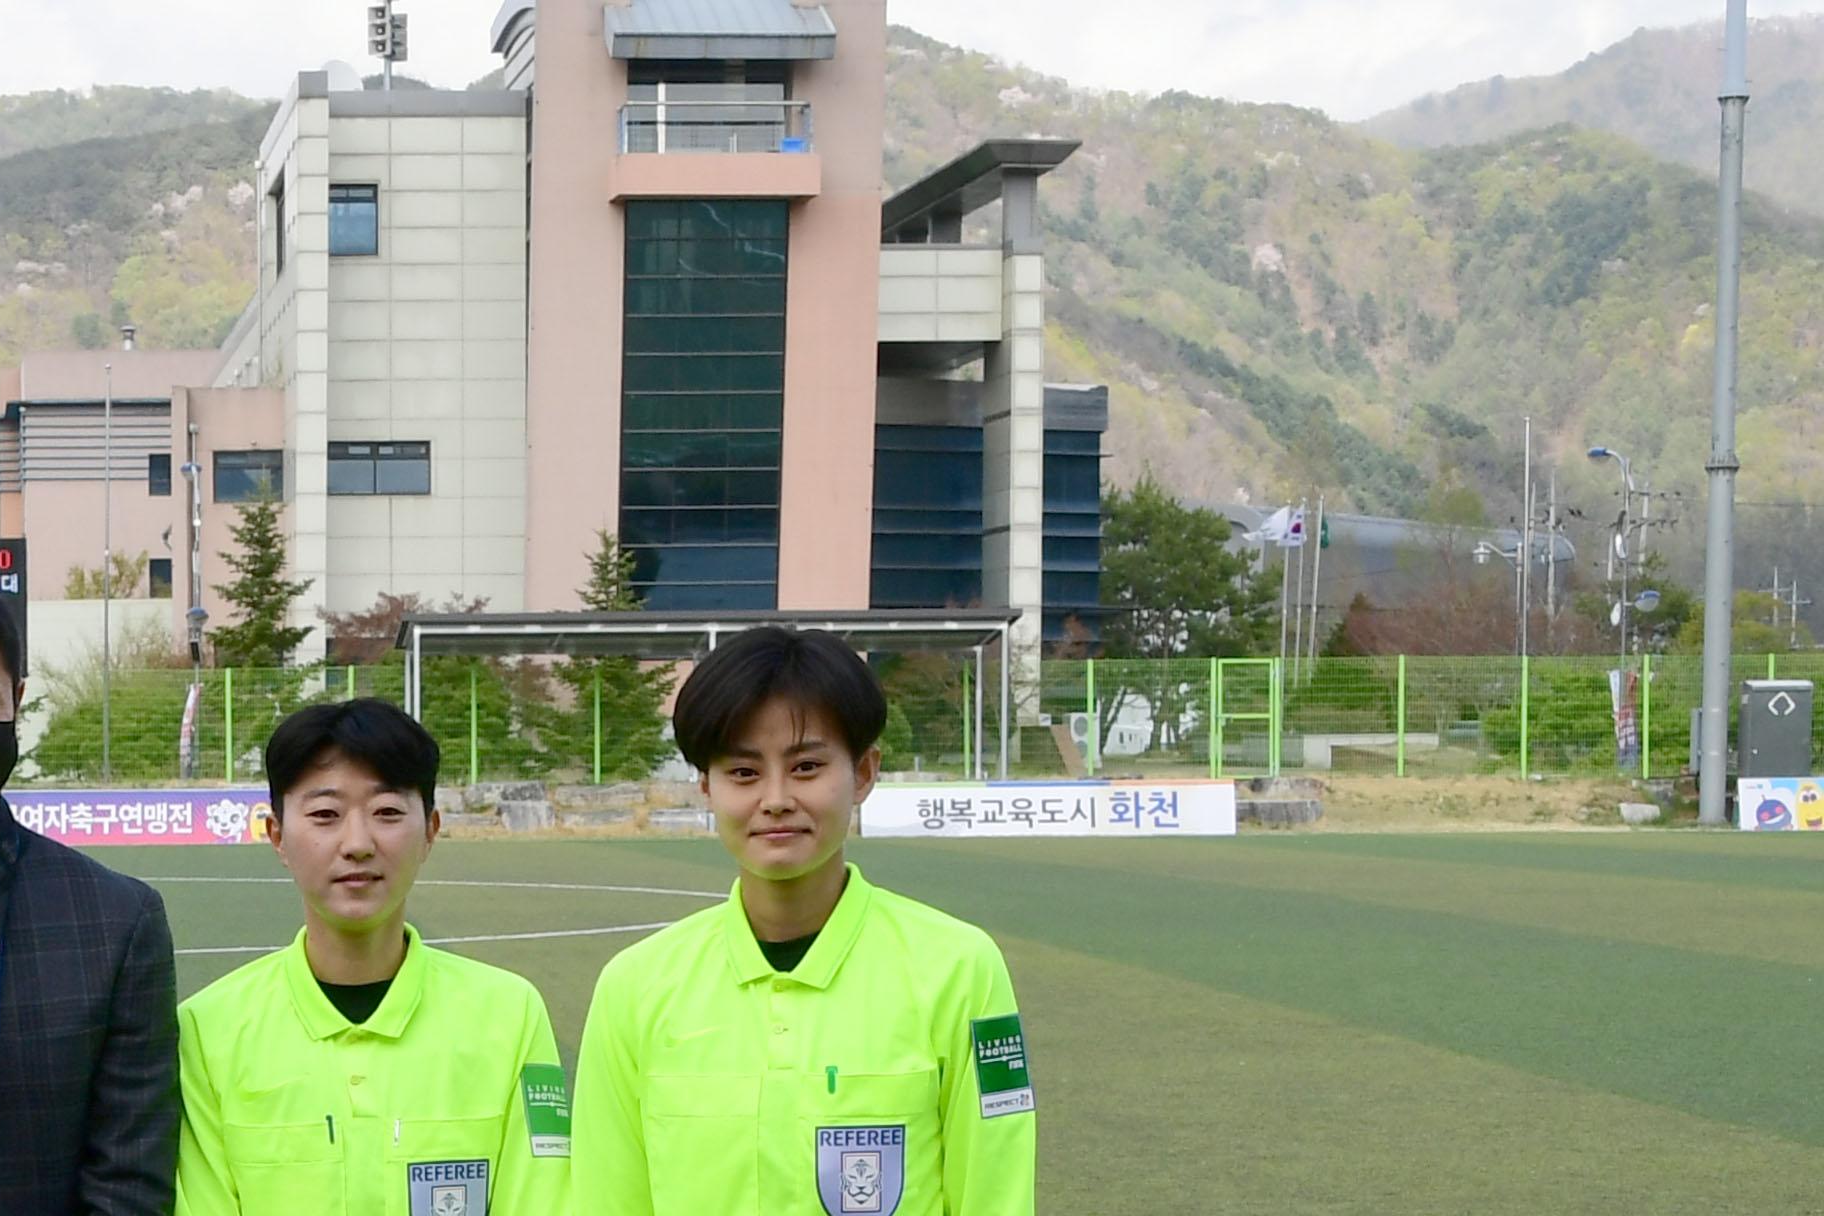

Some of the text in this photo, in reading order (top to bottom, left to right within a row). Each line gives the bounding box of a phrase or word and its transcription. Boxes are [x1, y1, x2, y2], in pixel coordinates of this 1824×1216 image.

[10, 802, 194, 835] 여자축구연맹전
[916, 790, 1181, 830] 행복교육도시 화천
[819, 1129, 902, 1147] REFEREE
[411, 1163, 486, 1182] REFEREE
